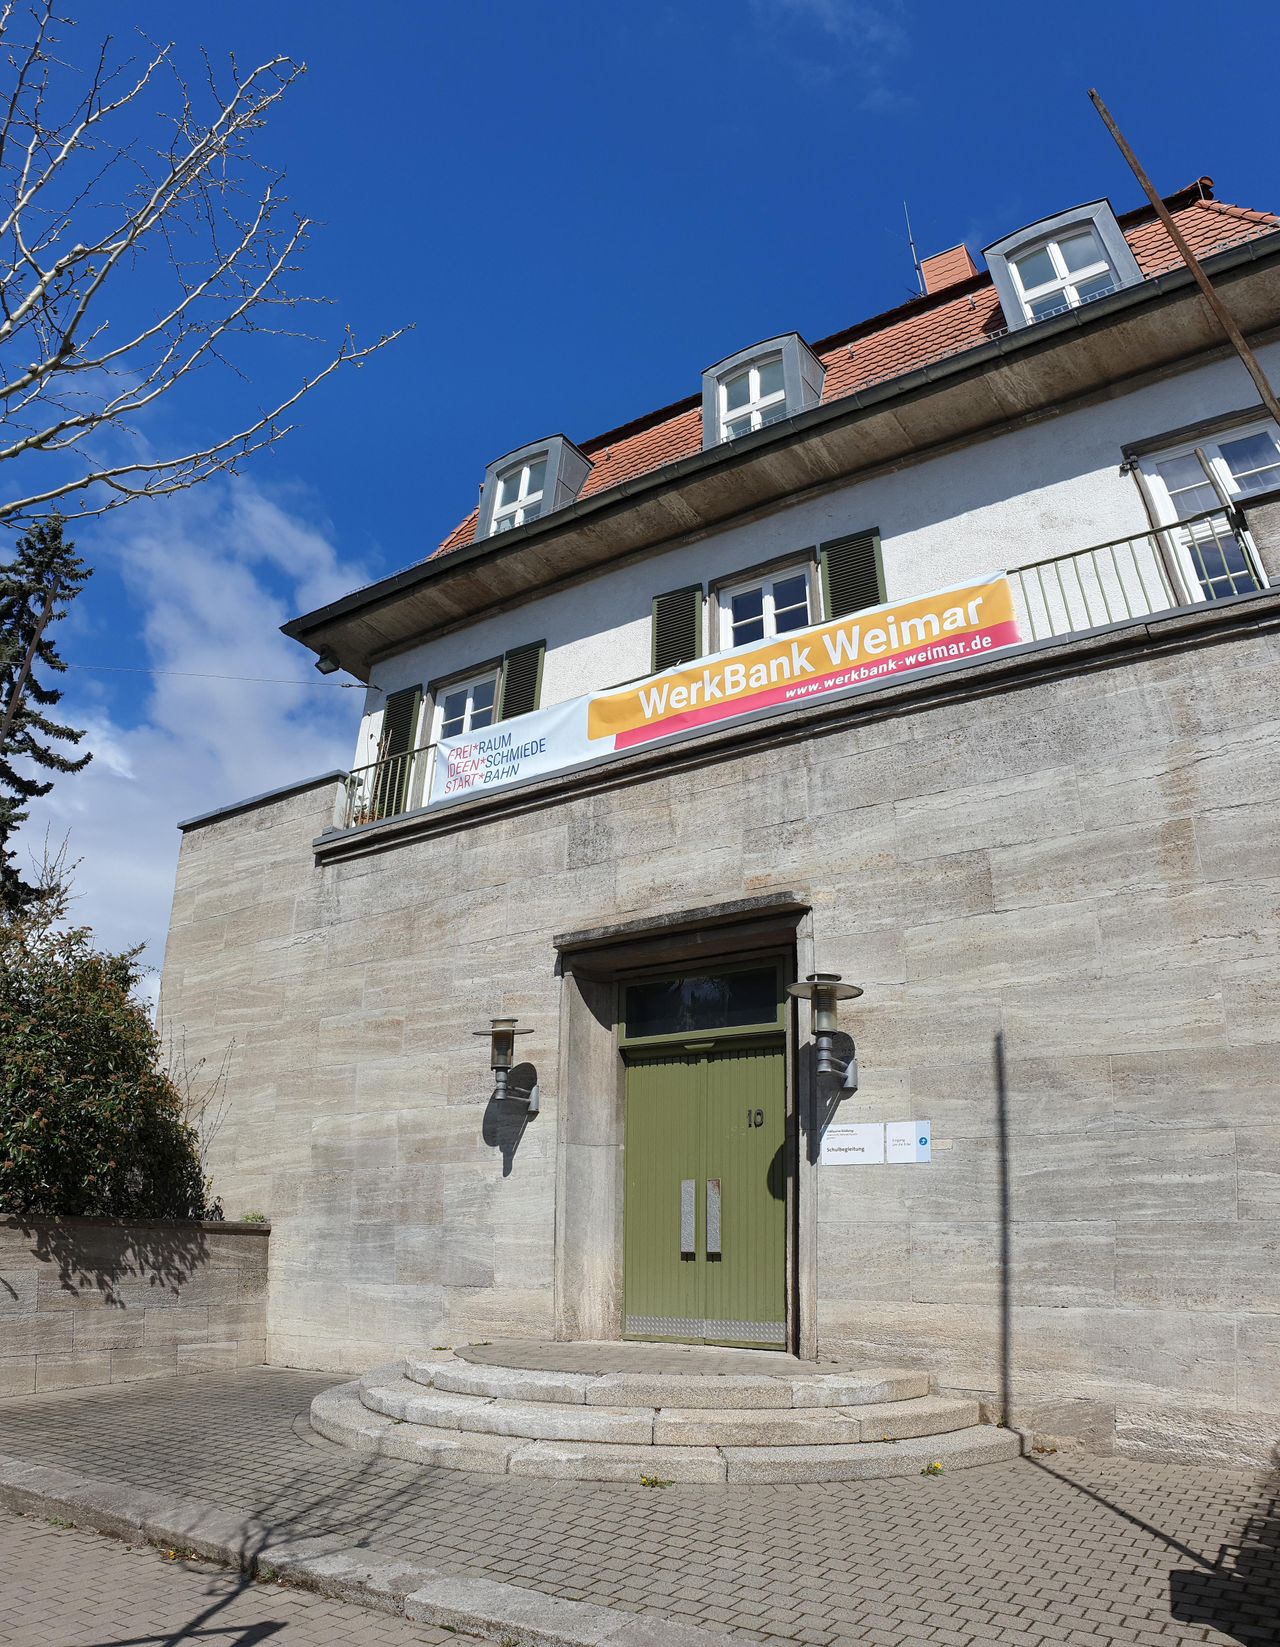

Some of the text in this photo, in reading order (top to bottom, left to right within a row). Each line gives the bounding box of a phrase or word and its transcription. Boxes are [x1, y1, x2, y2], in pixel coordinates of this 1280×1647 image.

[638, 595, 984, 719] WerkBank Weimar
[784, 634, 992, 699] www.werkbank-weimar.de
[748, 1109, 764, 1128] 10
